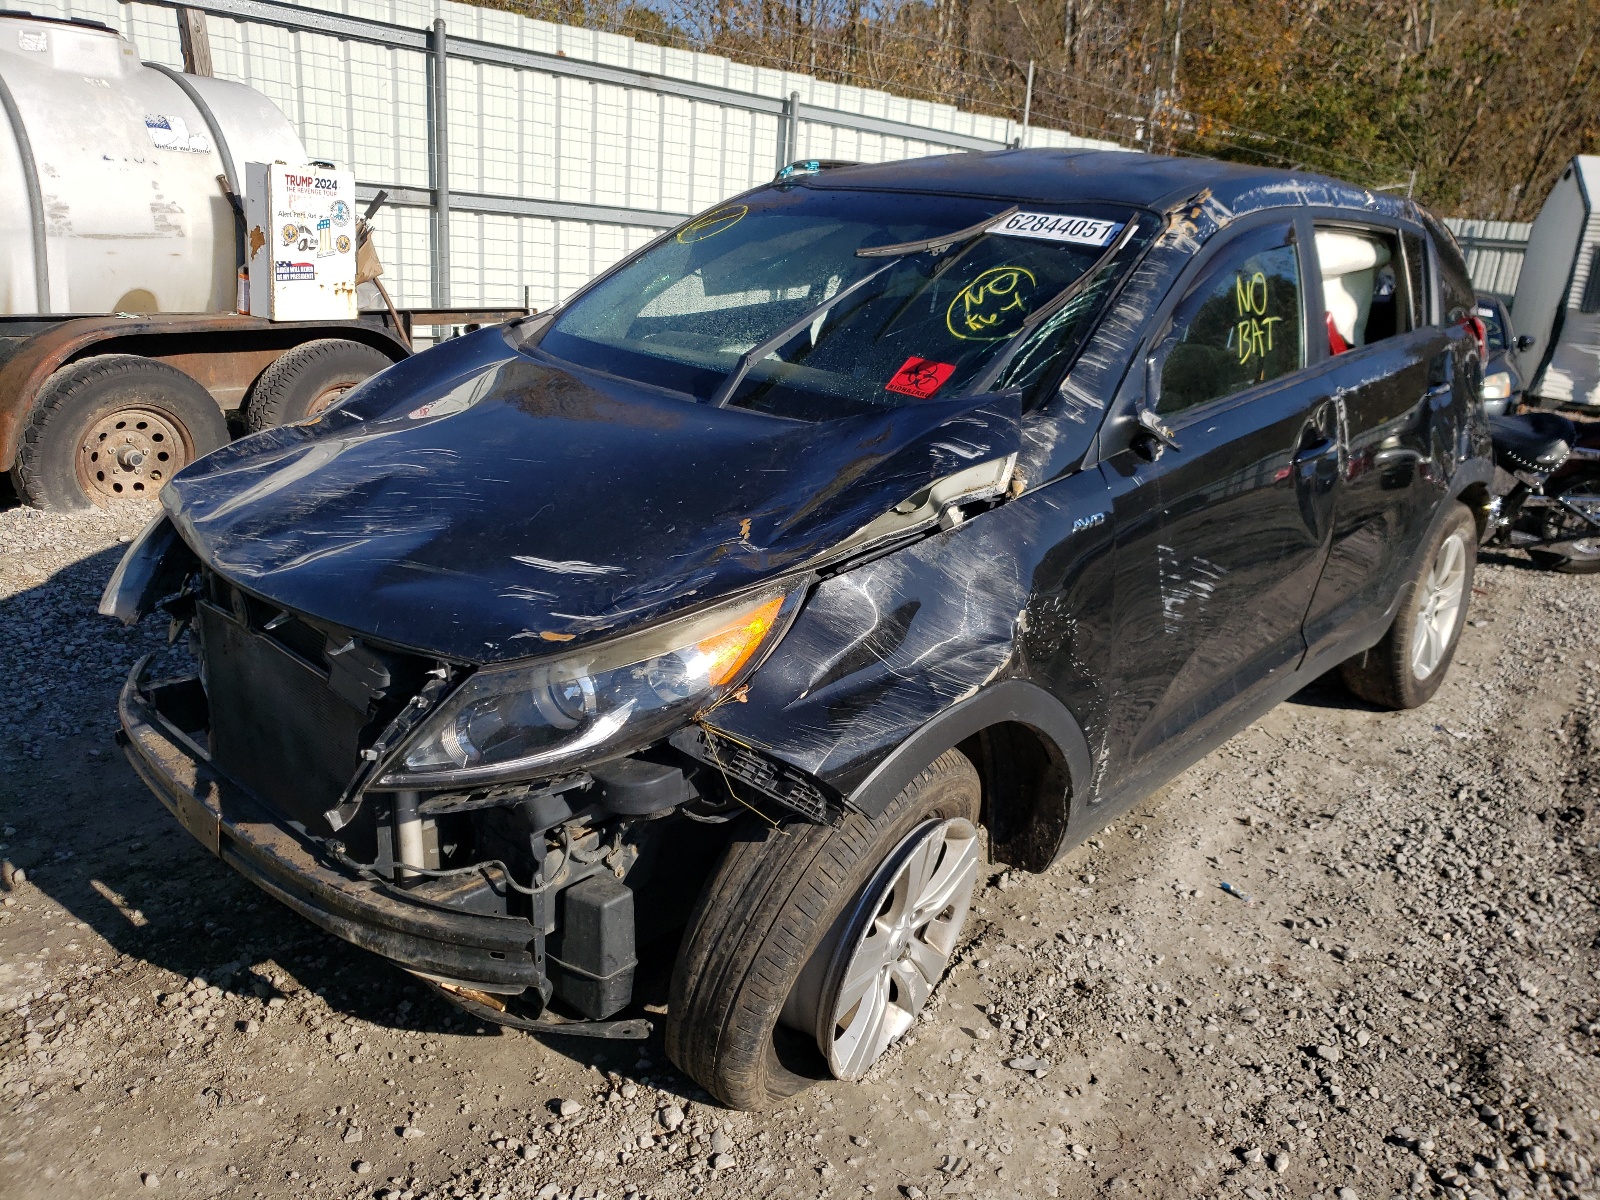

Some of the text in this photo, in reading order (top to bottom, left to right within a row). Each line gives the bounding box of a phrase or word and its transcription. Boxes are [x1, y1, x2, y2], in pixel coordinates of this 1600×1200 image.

[285, 174, 337, 190] TRUMP 2024
[298, 187, 322, 195] REVENGE
[1006, 213, 1115, 240] 62844051
[964, 272, 1018, 312] NO
[1236, 272, 1268, 317] NO
[1238, 316, 1283, 365] BAT
[1072, 512, 1105, 533] AWD
